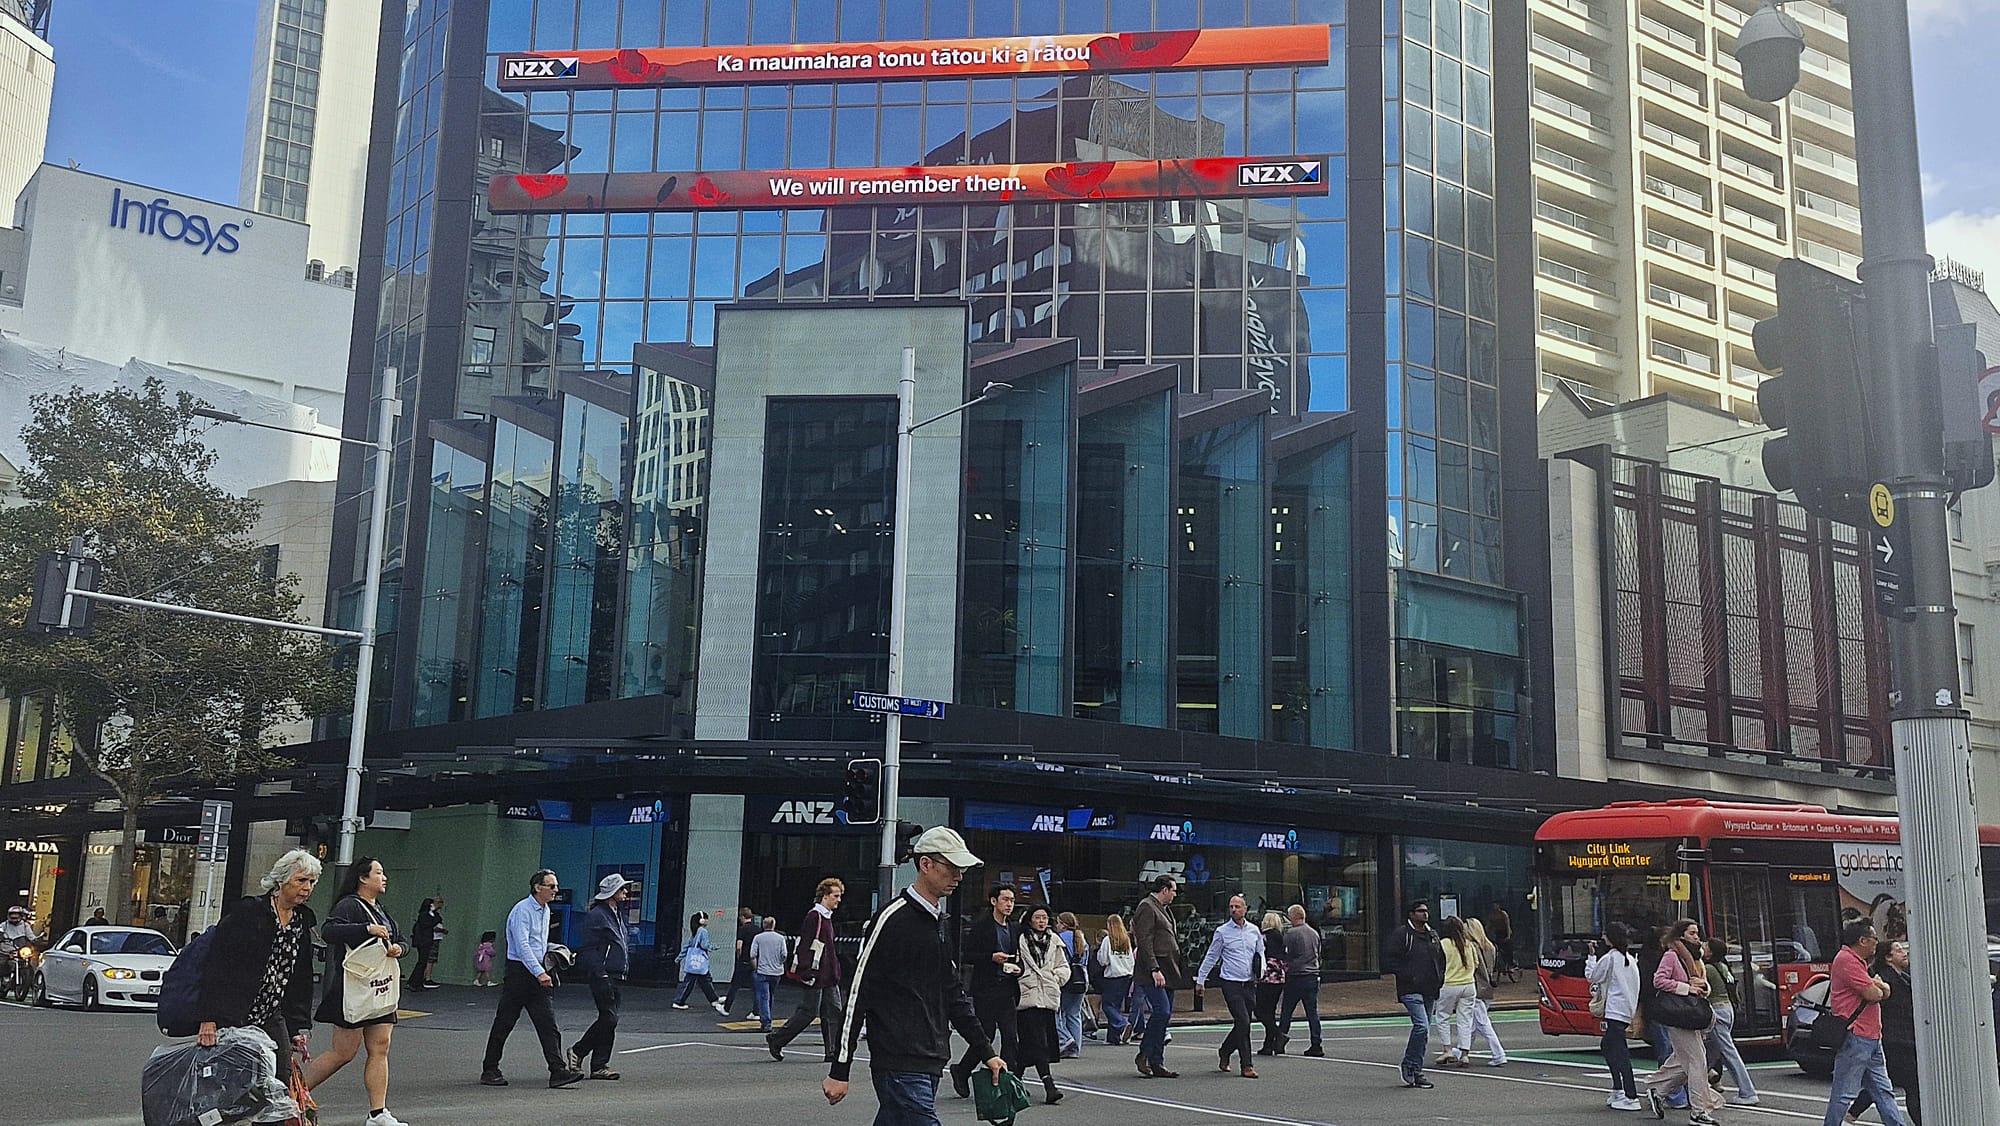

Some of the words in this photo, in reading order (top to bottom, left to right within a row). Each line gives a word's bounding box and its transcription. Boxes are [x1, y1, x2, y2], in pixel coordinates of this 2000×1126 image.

[717, 55, 743, 72] Ka
[749, 52, 872, 71] maumahara
[878, 51, 925, 67] tonu
[931, 48, 985, 65] tātou
[992, 46, 1010, 63] ki
[1015, 50, 1028, 62] a
[1034, 45, 1090, 62] rātou
[508, 61, 555, 77] NZX
[1242, 166, 1294, 183] NZX
[769, 178, 803, 195] We
[808, 177, 844, 195] will
[850, 175, 960, 195] remember
[966, 175, 1027, 193] them.
[110, 188, 240, 255] Infosys
[859, 695, 900, 711] CUSTOMS
[506, 806, 528, 816] ANZ
[628, 806, 652, 823] ANZ
[771, 801, 834, 824] ANZ
[1031, 814, 1064, 832] ANZ
[1091, 817, 1107, 826] ANZ
[1724, 820, 1750, 831] Wynyard
[1750, 822, 1774, 832] Quarter
[1782, 823, 1809, 832] Britomart
[1816, 824, 1834, 833] Queen
[1835, 825, 1842, 833] St
[1849, 825, 1862, 833] Town
[1863, 825, 1874, 834] Hall
[163, 828, 192, 842] Dior
[1150, 823, 1181, 841] ANZ
[4, 840, 59, 853] PRADA
[1257, 833, 1286, 849] ANZ
[1586, 843, 1606, 856] City
[1609, 843, 1630, 854] Link
[1568, 855, 1609, 868] Wynyard
[1612, 855, 1651, 867] Quarter
